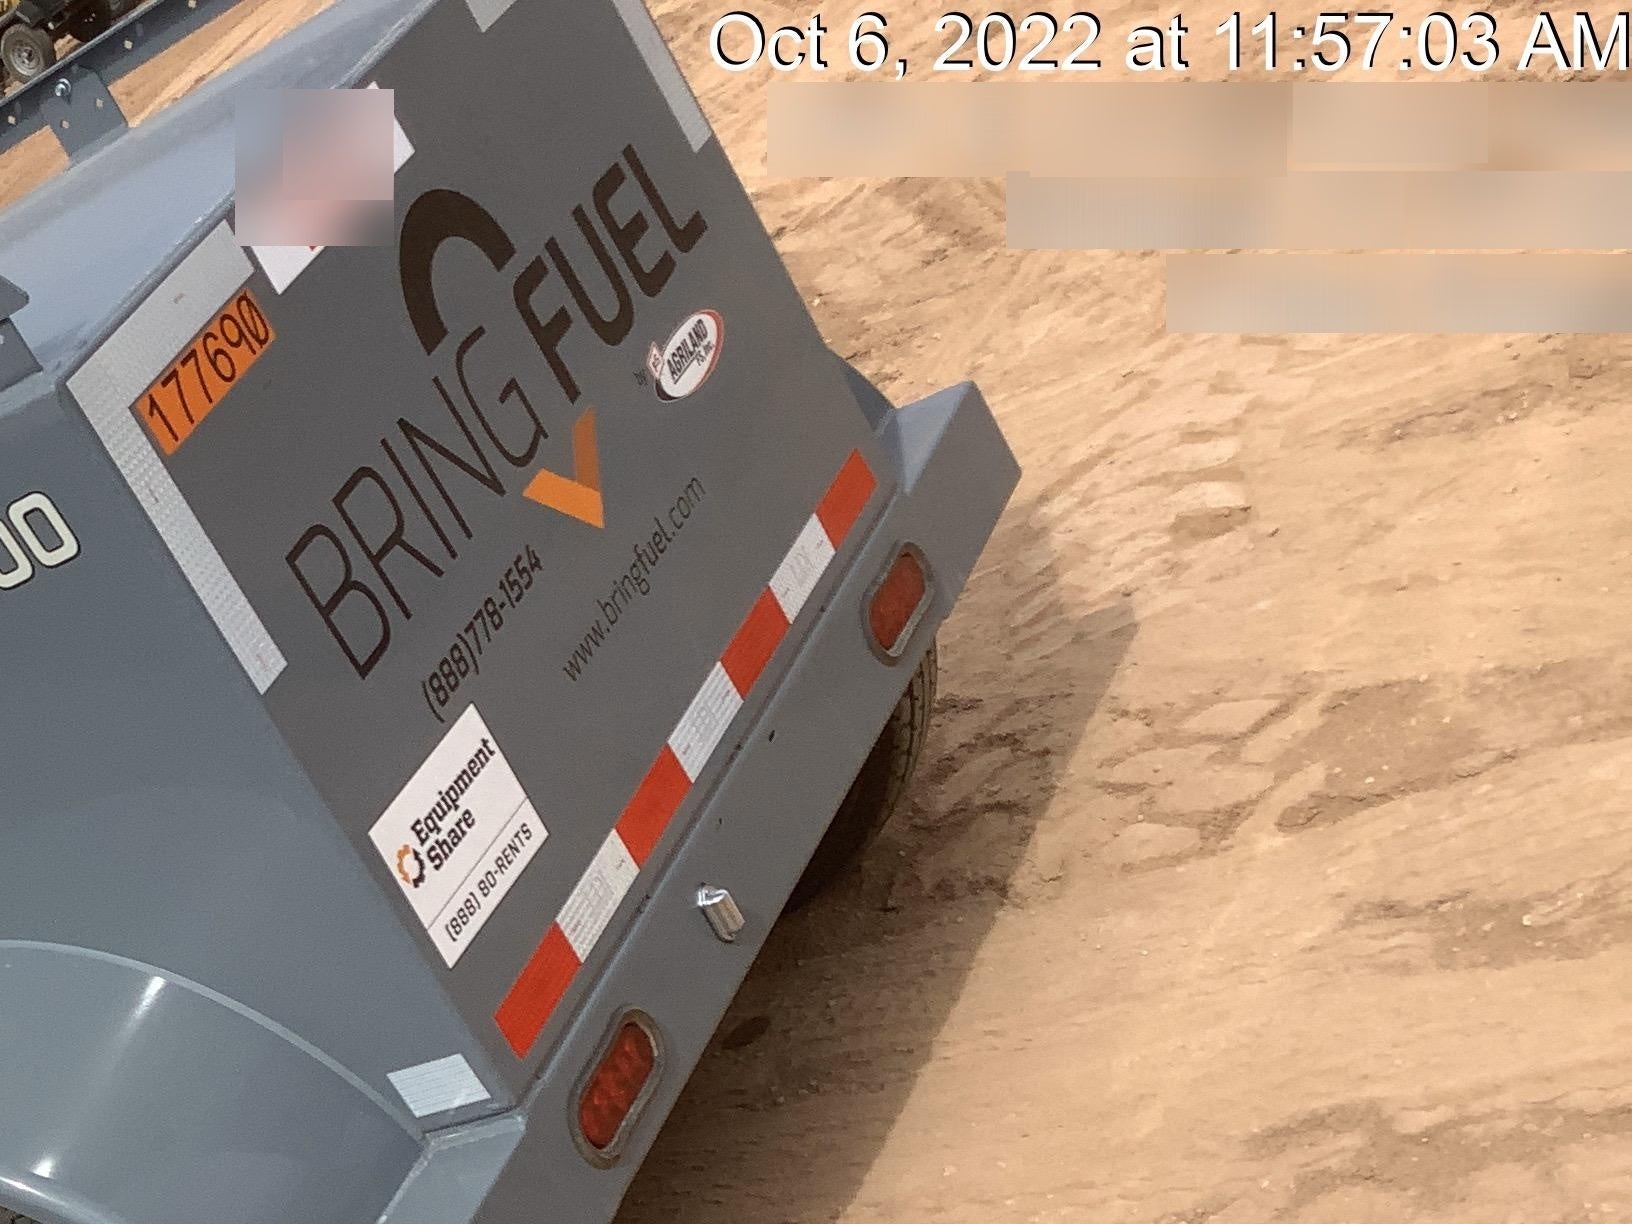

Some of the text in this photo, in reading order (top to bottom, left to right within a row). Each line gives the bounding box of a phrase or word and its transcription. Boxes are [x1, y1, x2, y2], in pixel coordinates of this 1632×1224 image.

[148, 291, 269, 442] 177690
[666, 318, 708, 381] AGRILAND
[563, 477, 706, 682] www.bringfuel.com
[410, 738, 496, 847] Equipment
[426, 808, 476, 871] Share
[445, 823, 533, 942] (888) 80-RENTS
